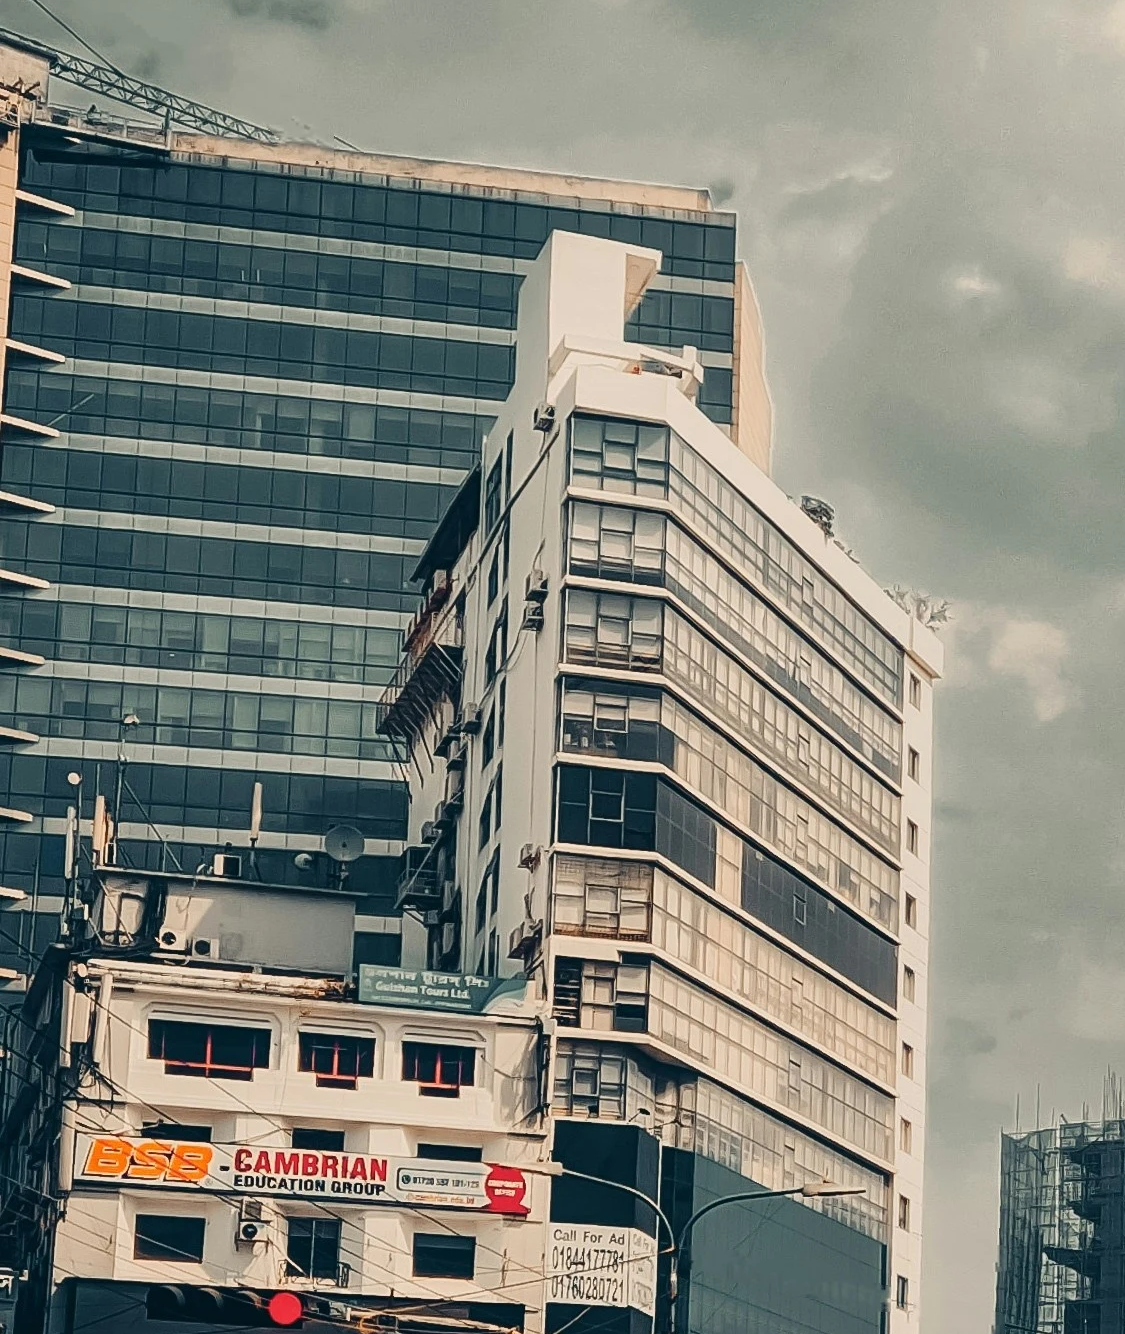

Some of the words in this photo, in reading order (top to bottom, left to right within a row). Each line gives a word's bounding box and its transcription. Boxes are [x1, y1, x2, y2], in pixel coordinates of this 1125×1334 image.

[419, 985, 449, 997] Tours
[82, 1138, 213, 1183] BSB
[233, 1147, 388, 1181] CAMBRIAN
[233, 1174, 326, 1192] EDUCATION
[330, 1181, 386, 1196] GROUP
[553, 1229, 577, 1241] Call
[583, 1231, 603, 1243] For
[609, 1233, 625, 1245] Ad
